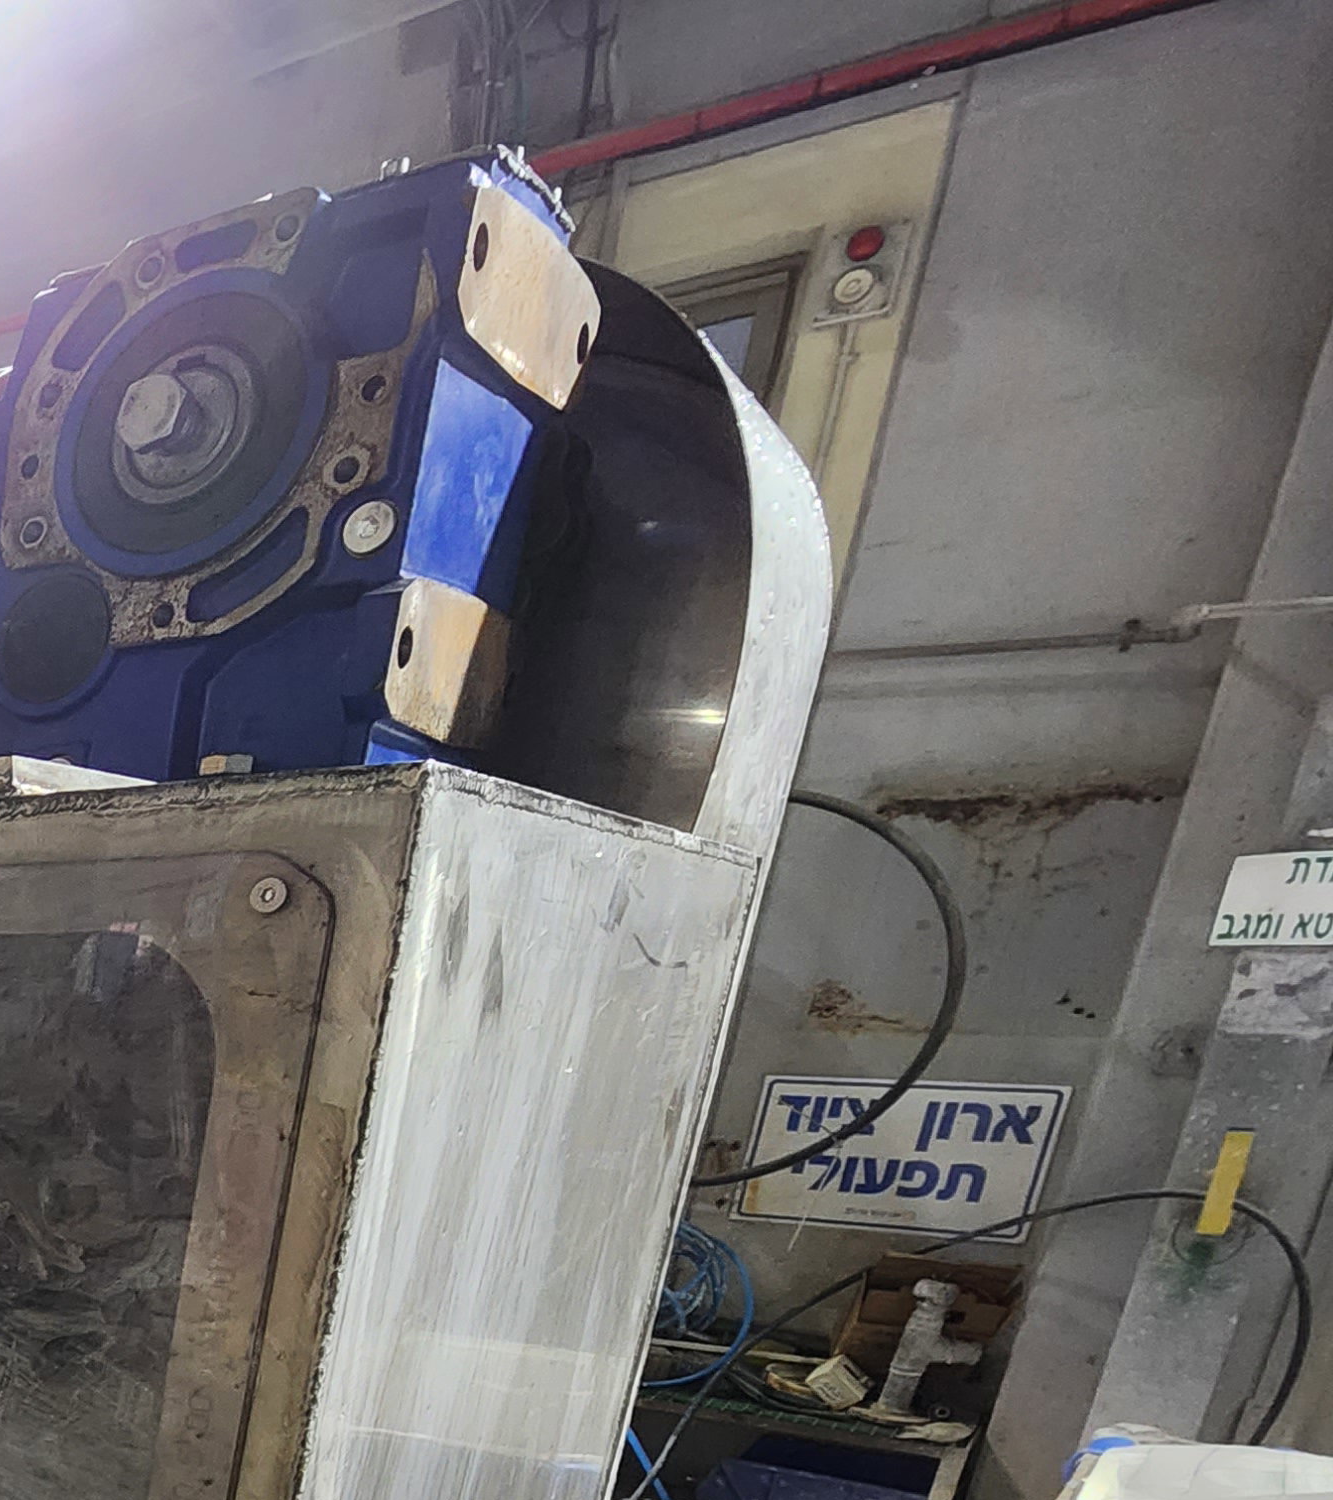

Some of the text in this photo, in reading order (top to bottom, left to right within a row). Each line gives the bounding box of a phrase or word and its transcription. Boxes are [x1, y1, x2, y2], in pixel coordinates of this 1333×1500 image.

[1285, 856, 1333, 884] דת
[1216, 913, 1284, 939] ומגב
[914, 1100, 1042, 1152] ארון
